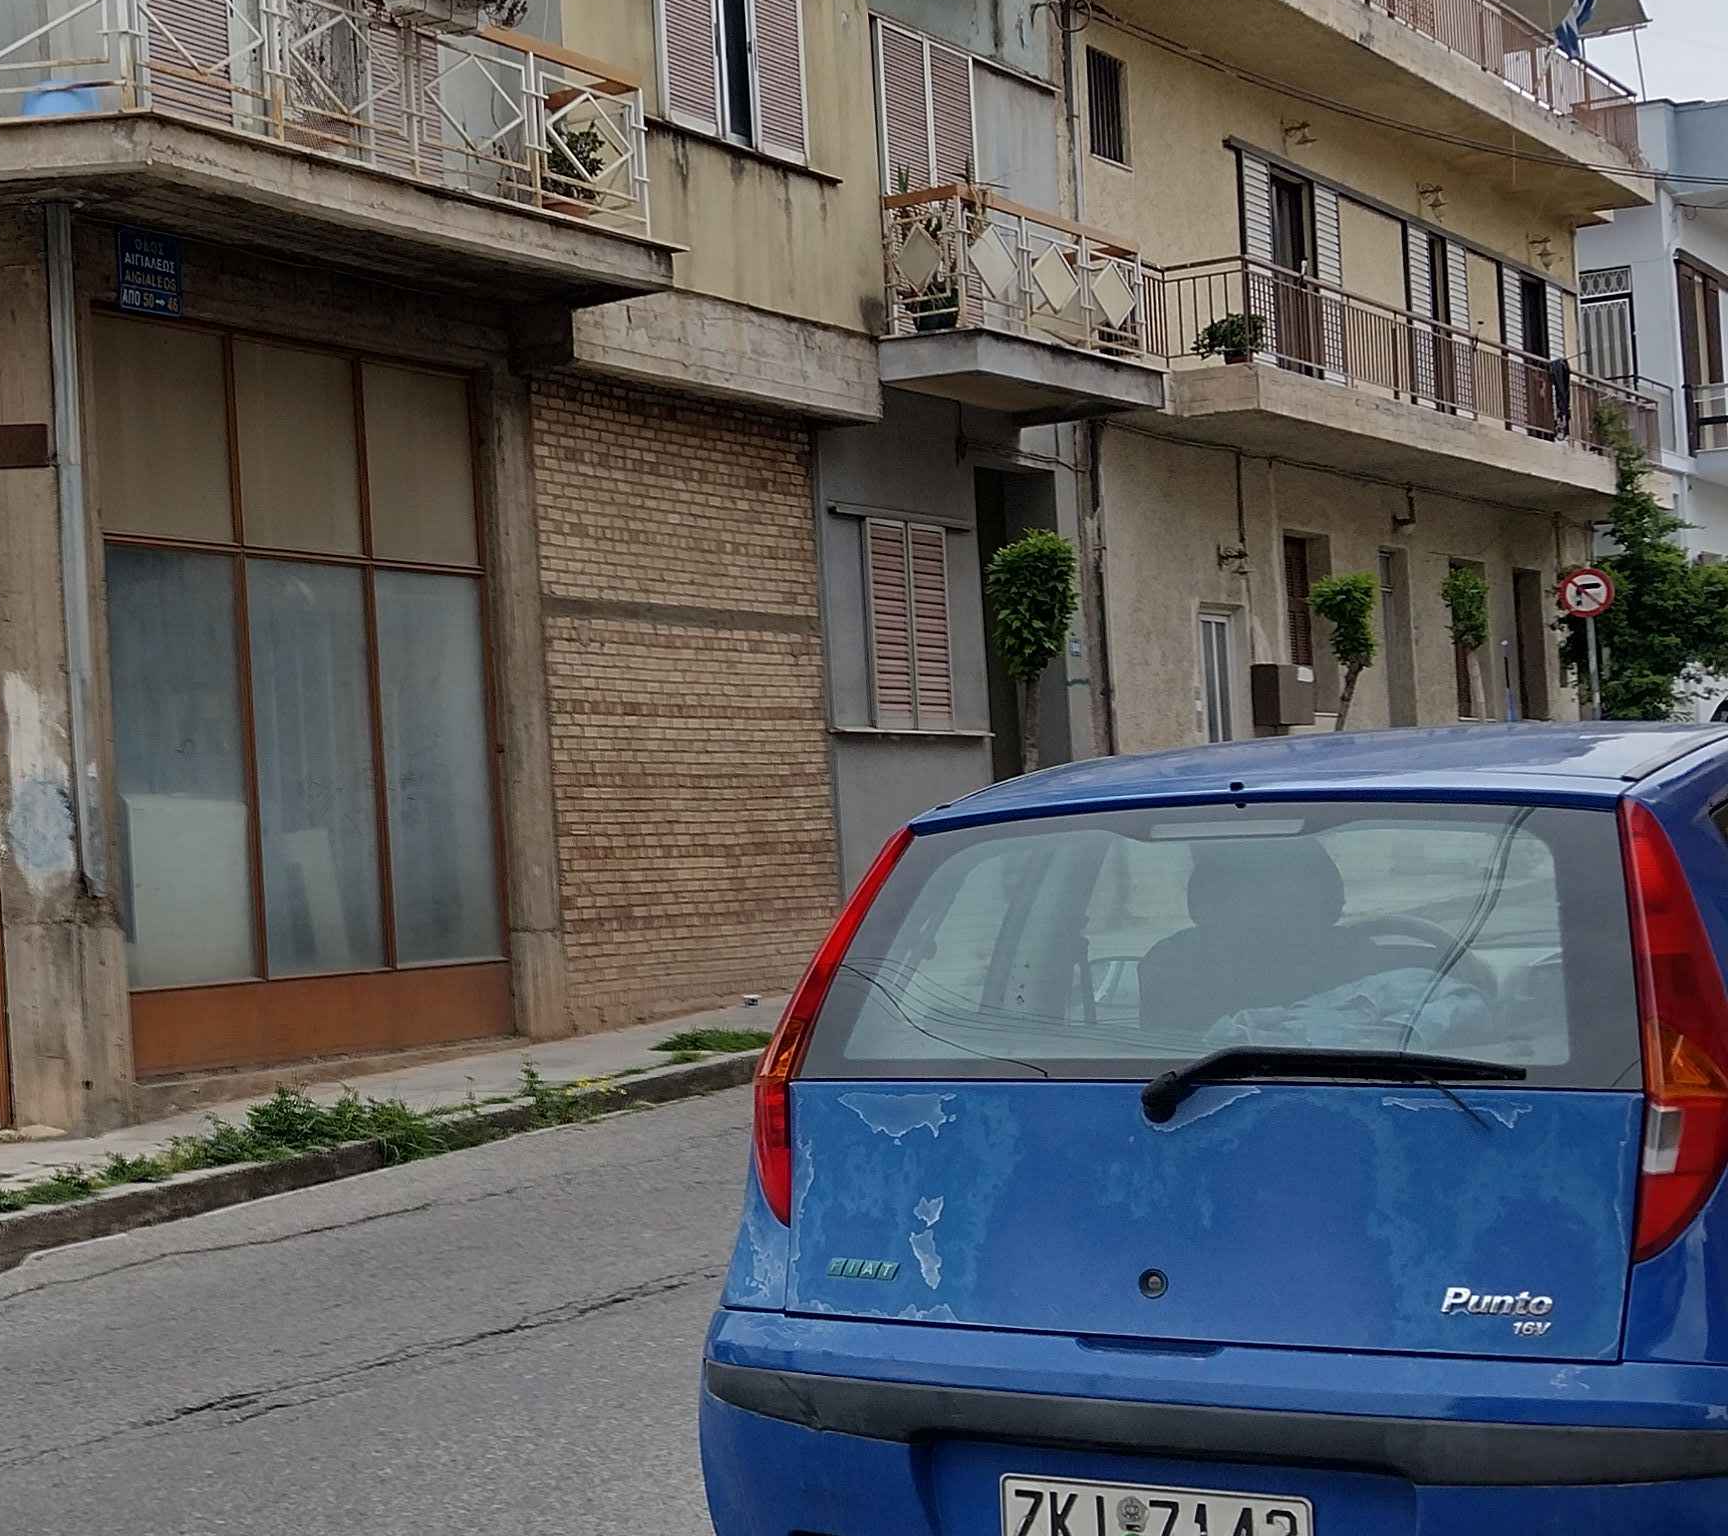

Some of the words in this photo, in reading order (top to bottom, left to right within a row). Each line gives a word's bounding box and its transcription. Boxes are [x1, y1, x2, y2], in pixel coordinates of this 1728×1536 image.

[124, 252, 176, 274] ΑΙΓΙΑΛΕΩΣ
[125, 269, 177, 291] AIGIALEOS
[122, 288, 141, 306] ΑΠΟ
[143, 292, 155, 308] 50
[829, 1260, 896, 1278] FIAT
[1440, 1286, 1553, 1315] Punto
[1512, 1321, 1552, 1335] 16V
